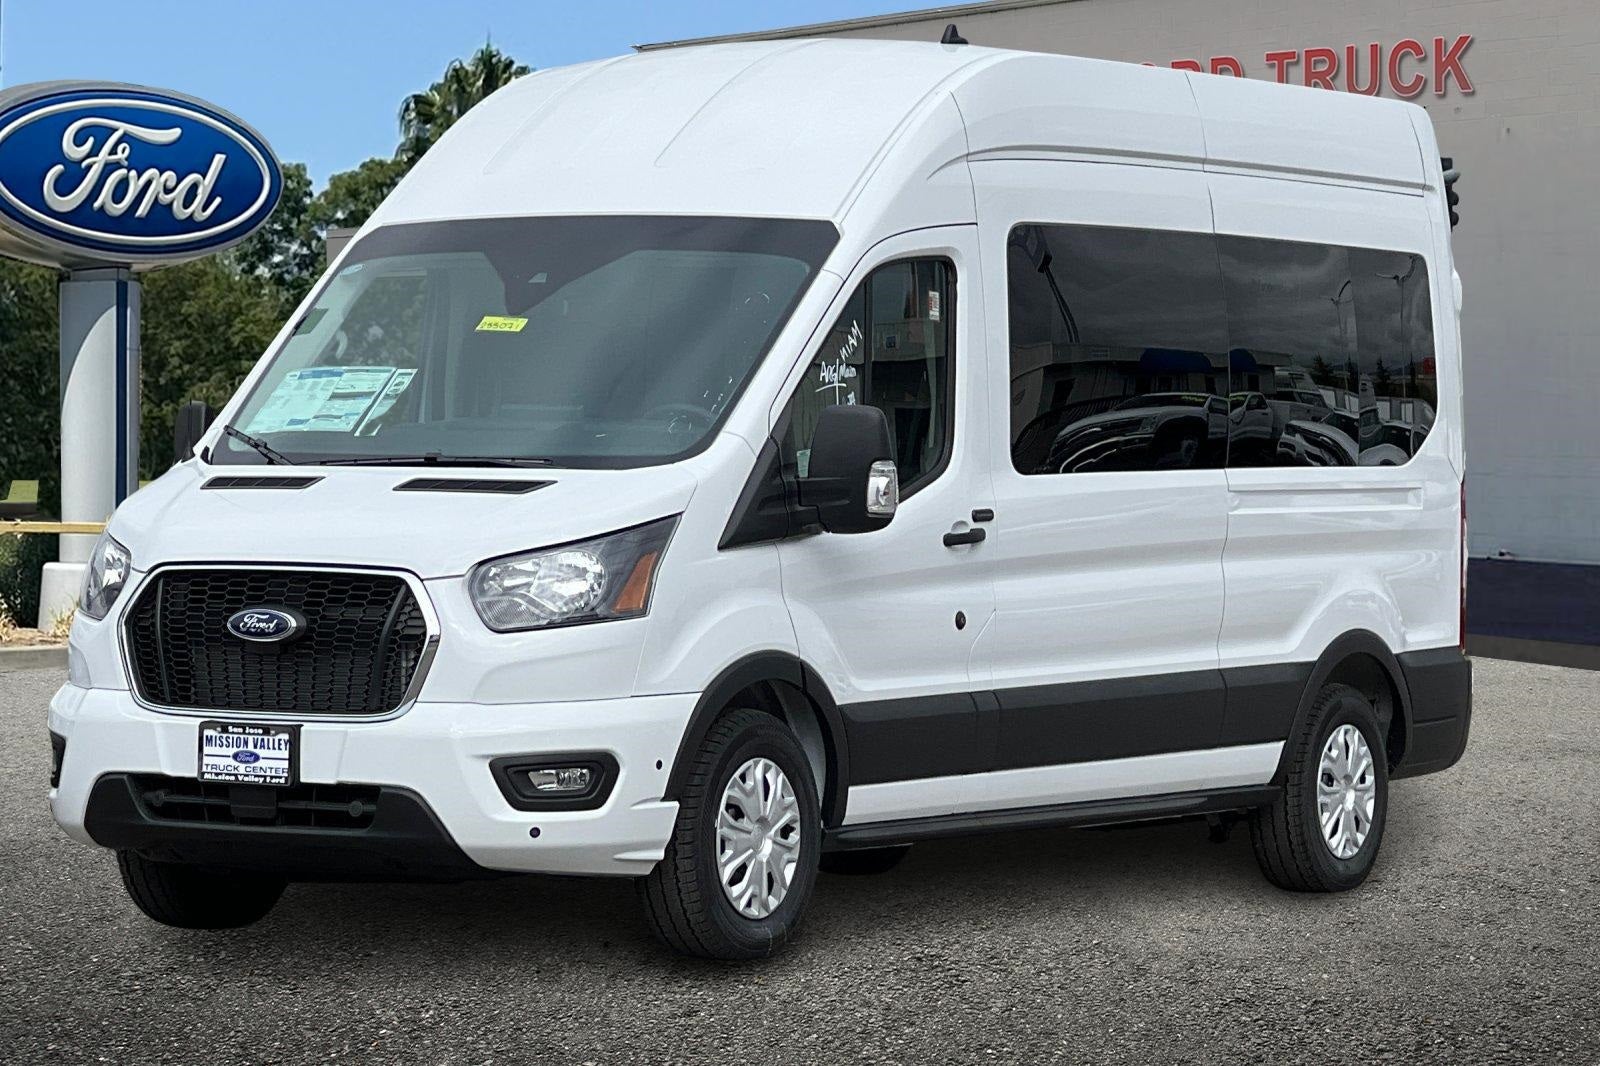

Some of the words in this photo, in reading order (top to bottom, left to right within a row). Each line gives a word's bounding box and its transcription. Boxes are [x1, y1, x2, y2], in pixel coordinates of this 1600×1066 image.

[1265, 34, 1473, 97] TRUCK
[43, 117, 227, 223] Ford
[239, 613, 278, 633] Ford
[228, 726, 243, 734] San
[245, 726, 263, 734] Jose
[205, 735, 249, 749] MISSION
[252, 737, 290, 751] VALLEY
[236, 752, 256, 762] Ford
[204, 763, 240, 772] TRUCK
[203, 773, 235, 781] Mission
[238, 775, 264, 784] Valley
[266, 776, 286, 784] Ford
